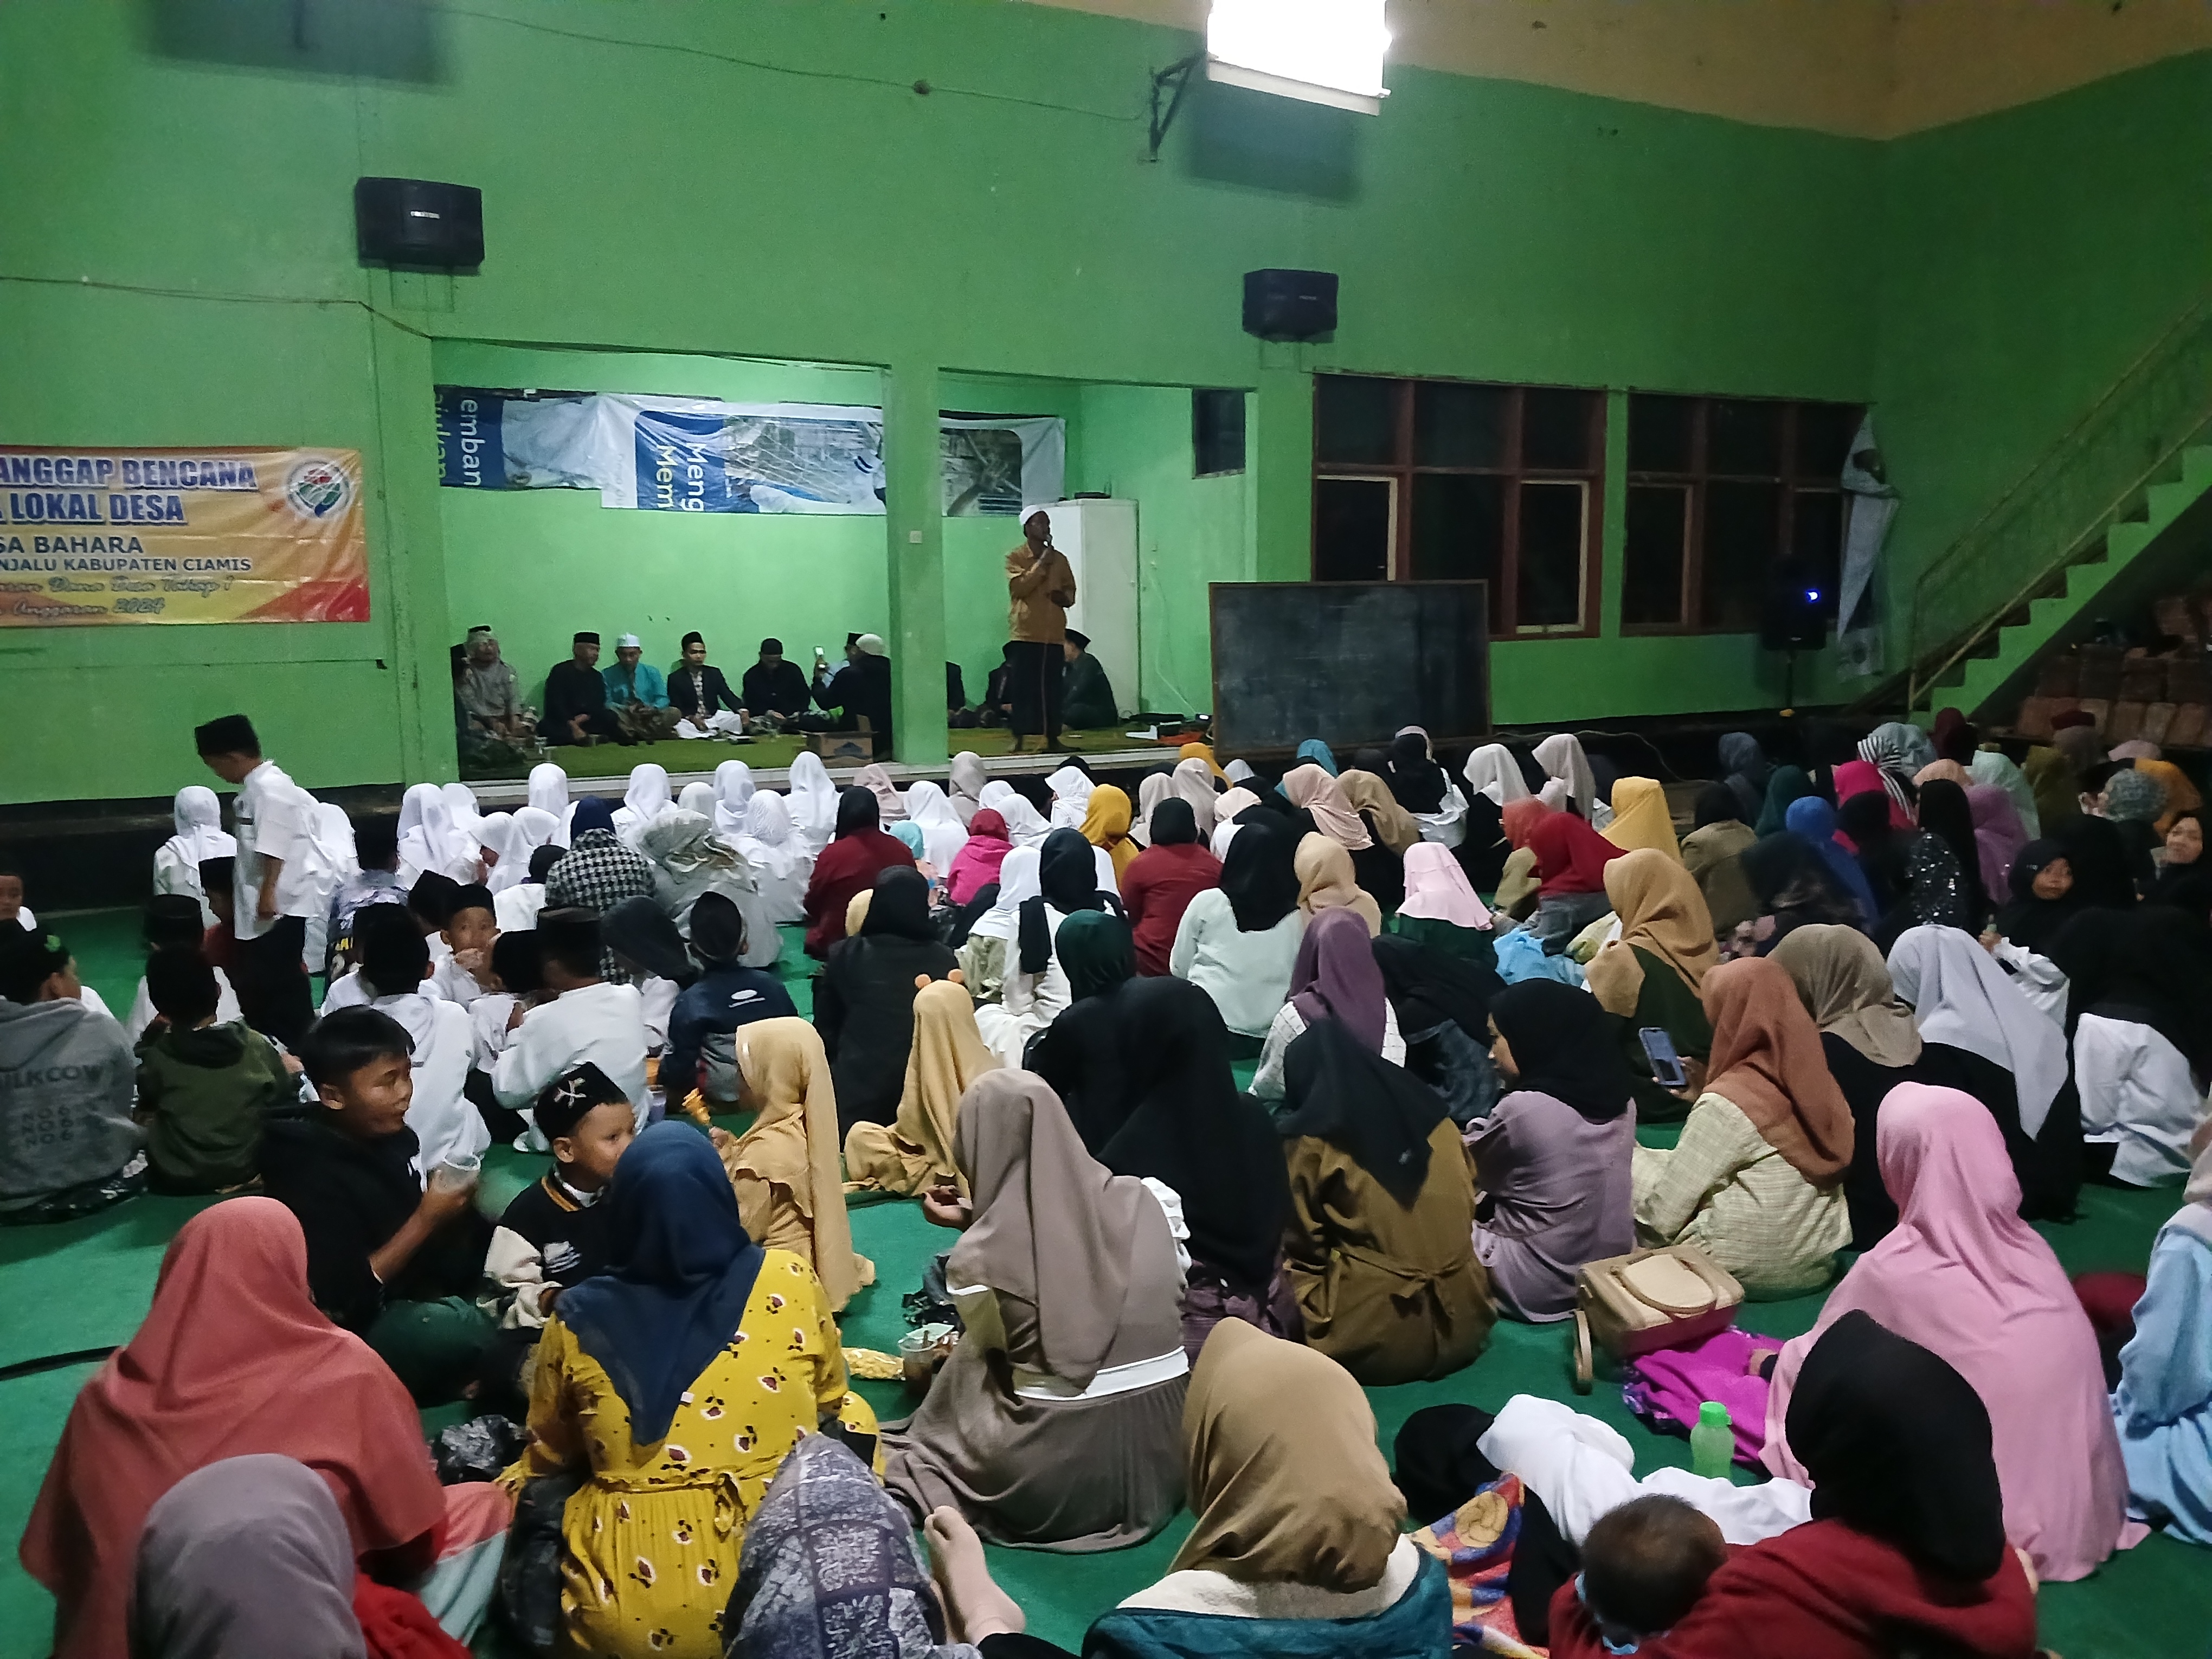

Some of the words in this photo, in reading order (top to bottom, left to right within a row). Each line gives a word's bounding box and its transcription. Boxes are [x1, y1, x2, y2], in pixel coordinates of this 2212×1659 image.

[122, 459, 258, 488] BENCANA
[10, 492, 102, 520] LOKAL
[109, 494, 184, 521] DESA
[34, 536, 144, 554] BAHARA
[64, 558, 177, 571] KABUPATEN
[183, 558, 252, 571] CIAMIS
